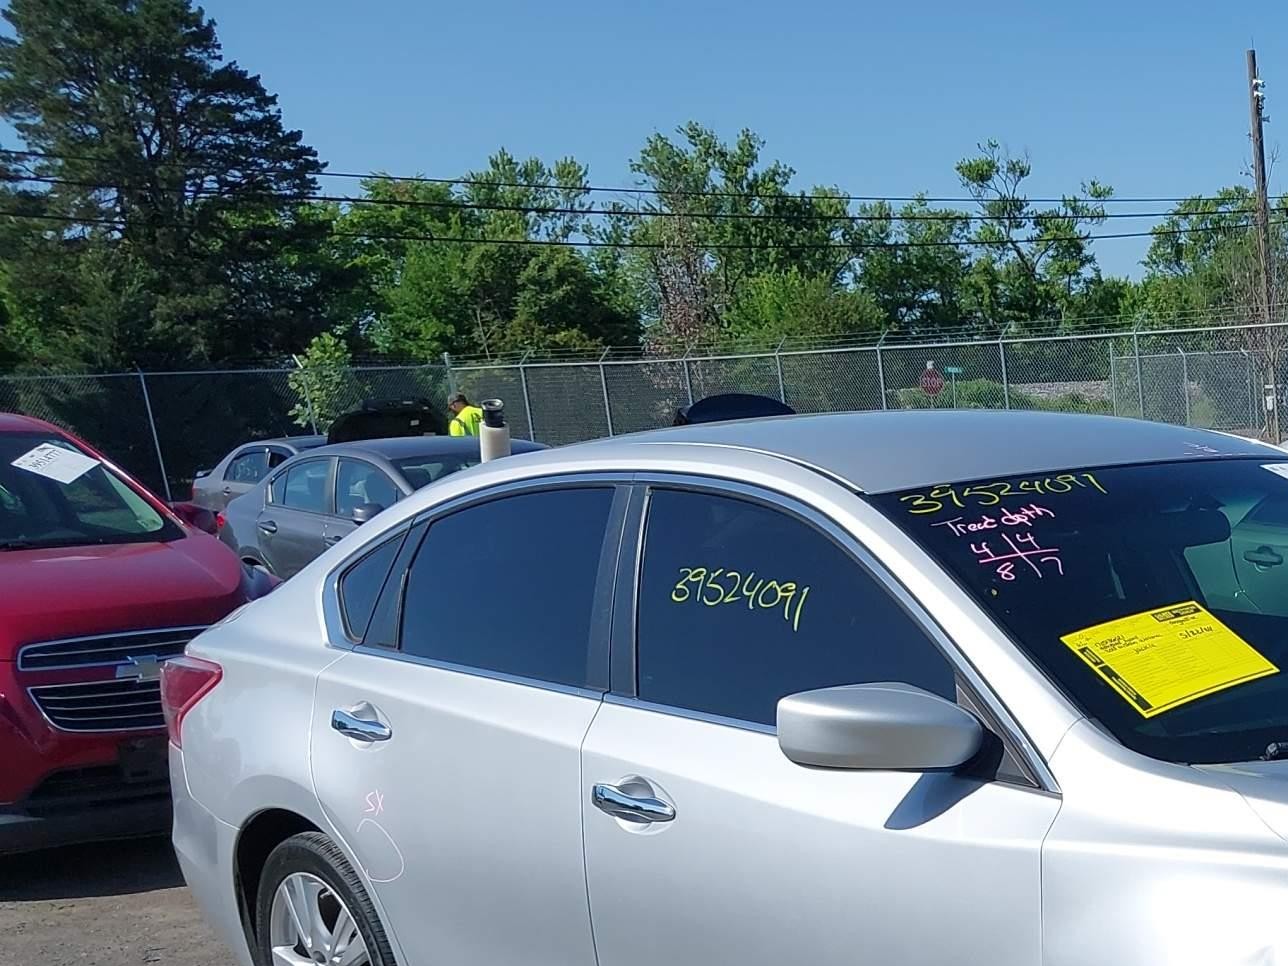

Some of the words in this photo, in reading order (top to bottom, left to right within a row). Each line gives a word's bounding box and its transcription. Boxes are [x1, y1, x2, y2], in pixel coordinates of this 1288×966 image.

[900, 473, 1109, 514] 39524091
[970, 541, 996, 559] 4
[1015, 531, 1042, 550] 4
[996, 561, 1016, 581] 8
[1040, 556, 1065, 576] 7
[671, 567, 810, 632] 39524091
